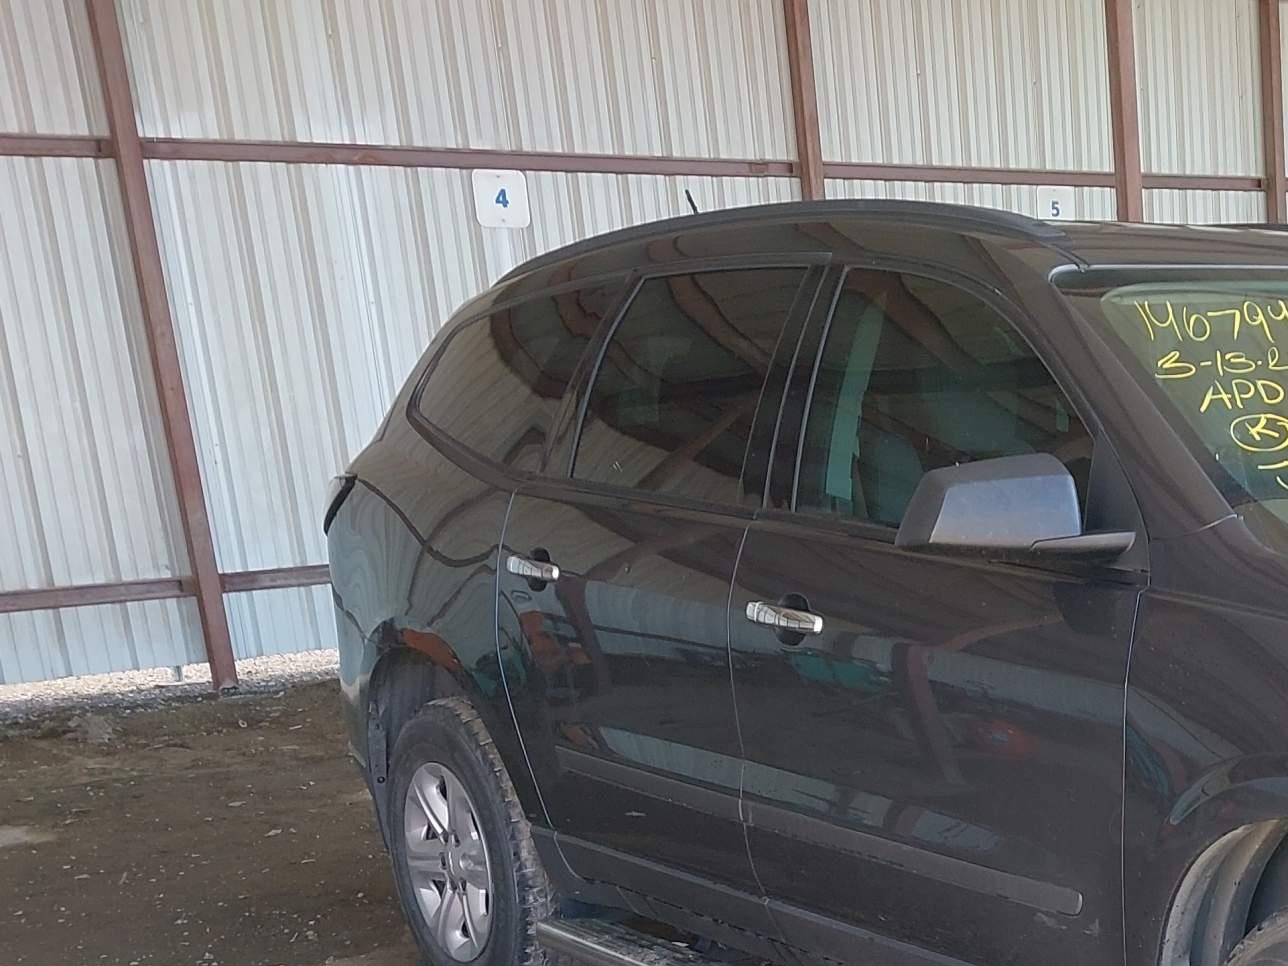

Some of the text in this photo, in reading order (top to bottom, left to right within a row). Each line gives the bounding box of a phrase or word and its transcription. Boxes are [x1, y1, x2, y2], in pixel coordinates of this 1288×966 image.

[494, 187, 510, 208] 4
[1051, 200, 1061, 217] 5
[1199, 379, 1285, 413] APD
